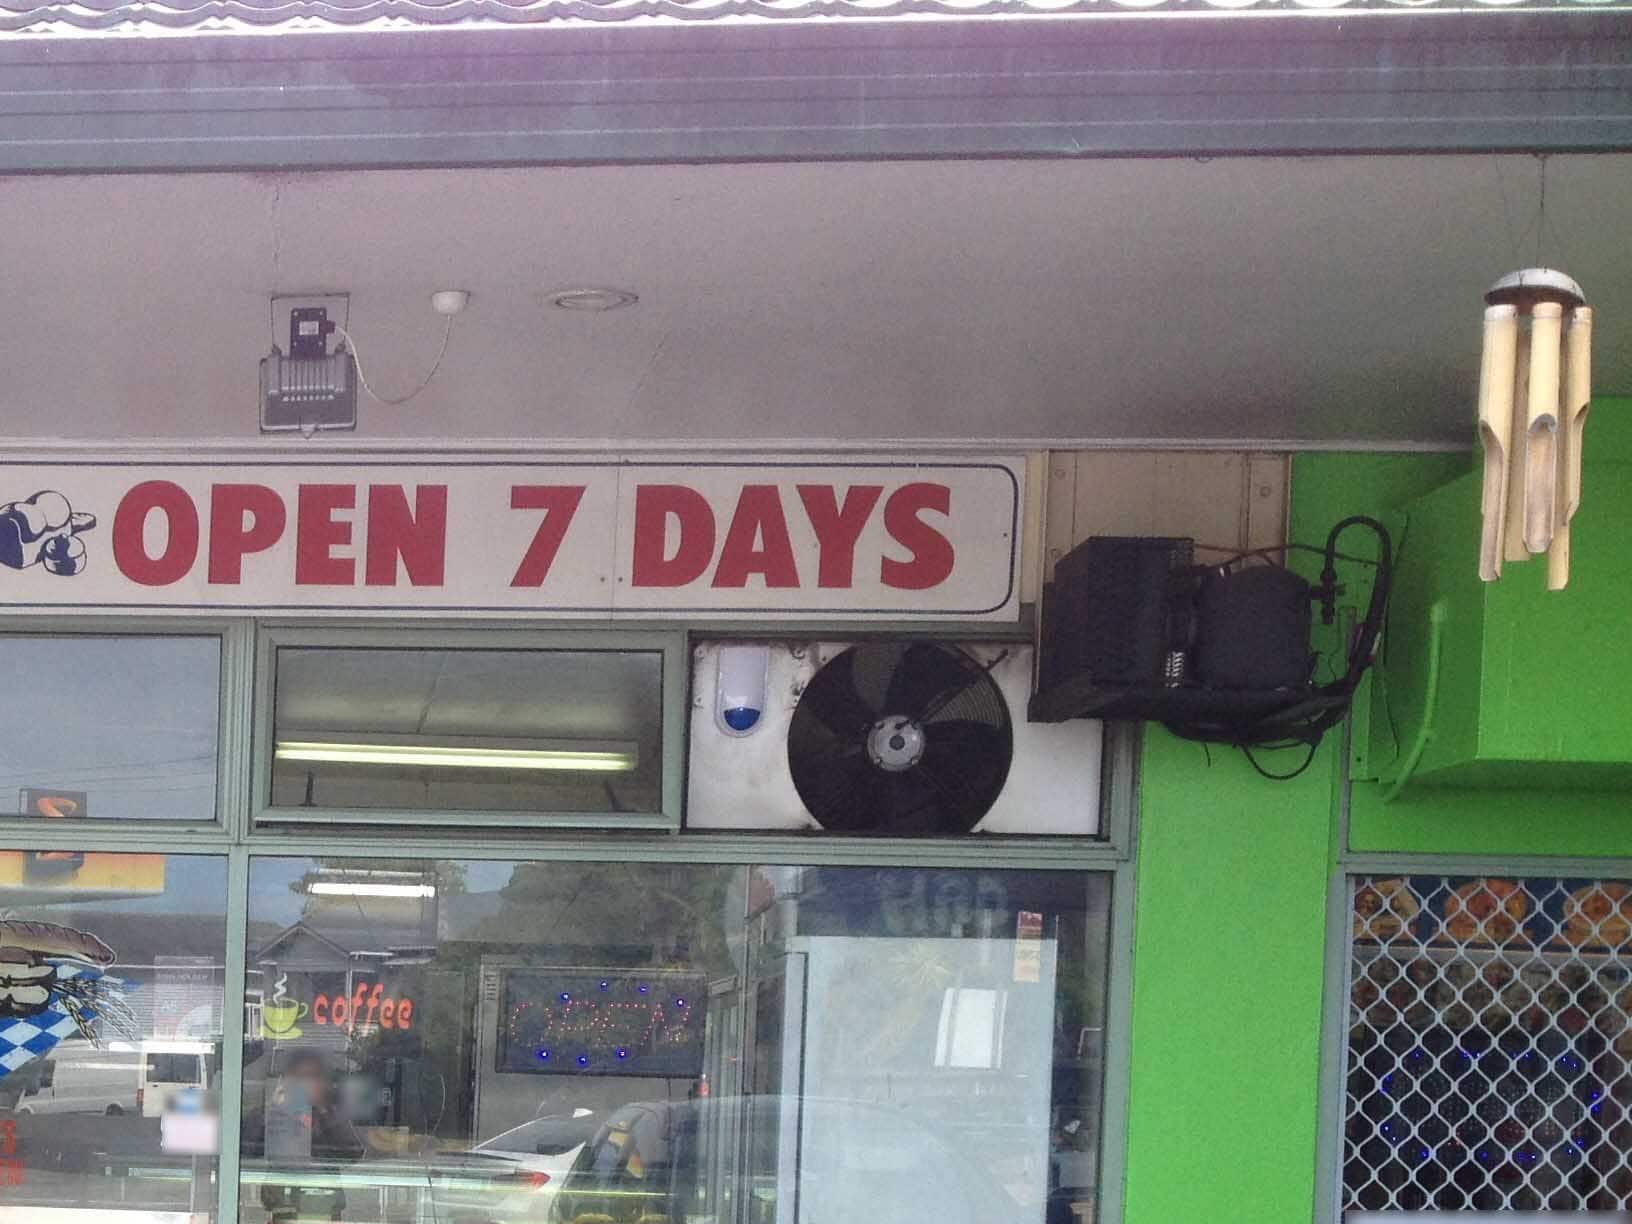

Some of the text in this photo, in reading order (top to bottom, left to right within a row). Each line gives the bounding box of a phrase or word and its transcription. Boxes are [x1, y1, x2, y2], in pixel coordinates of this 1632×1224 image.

[114, 481, 448, 586] OPEN
[511, 487, 581, 587] 7
[633, 484, 954, 588] DAYS
[313, 982, 414, 1029] coffee
